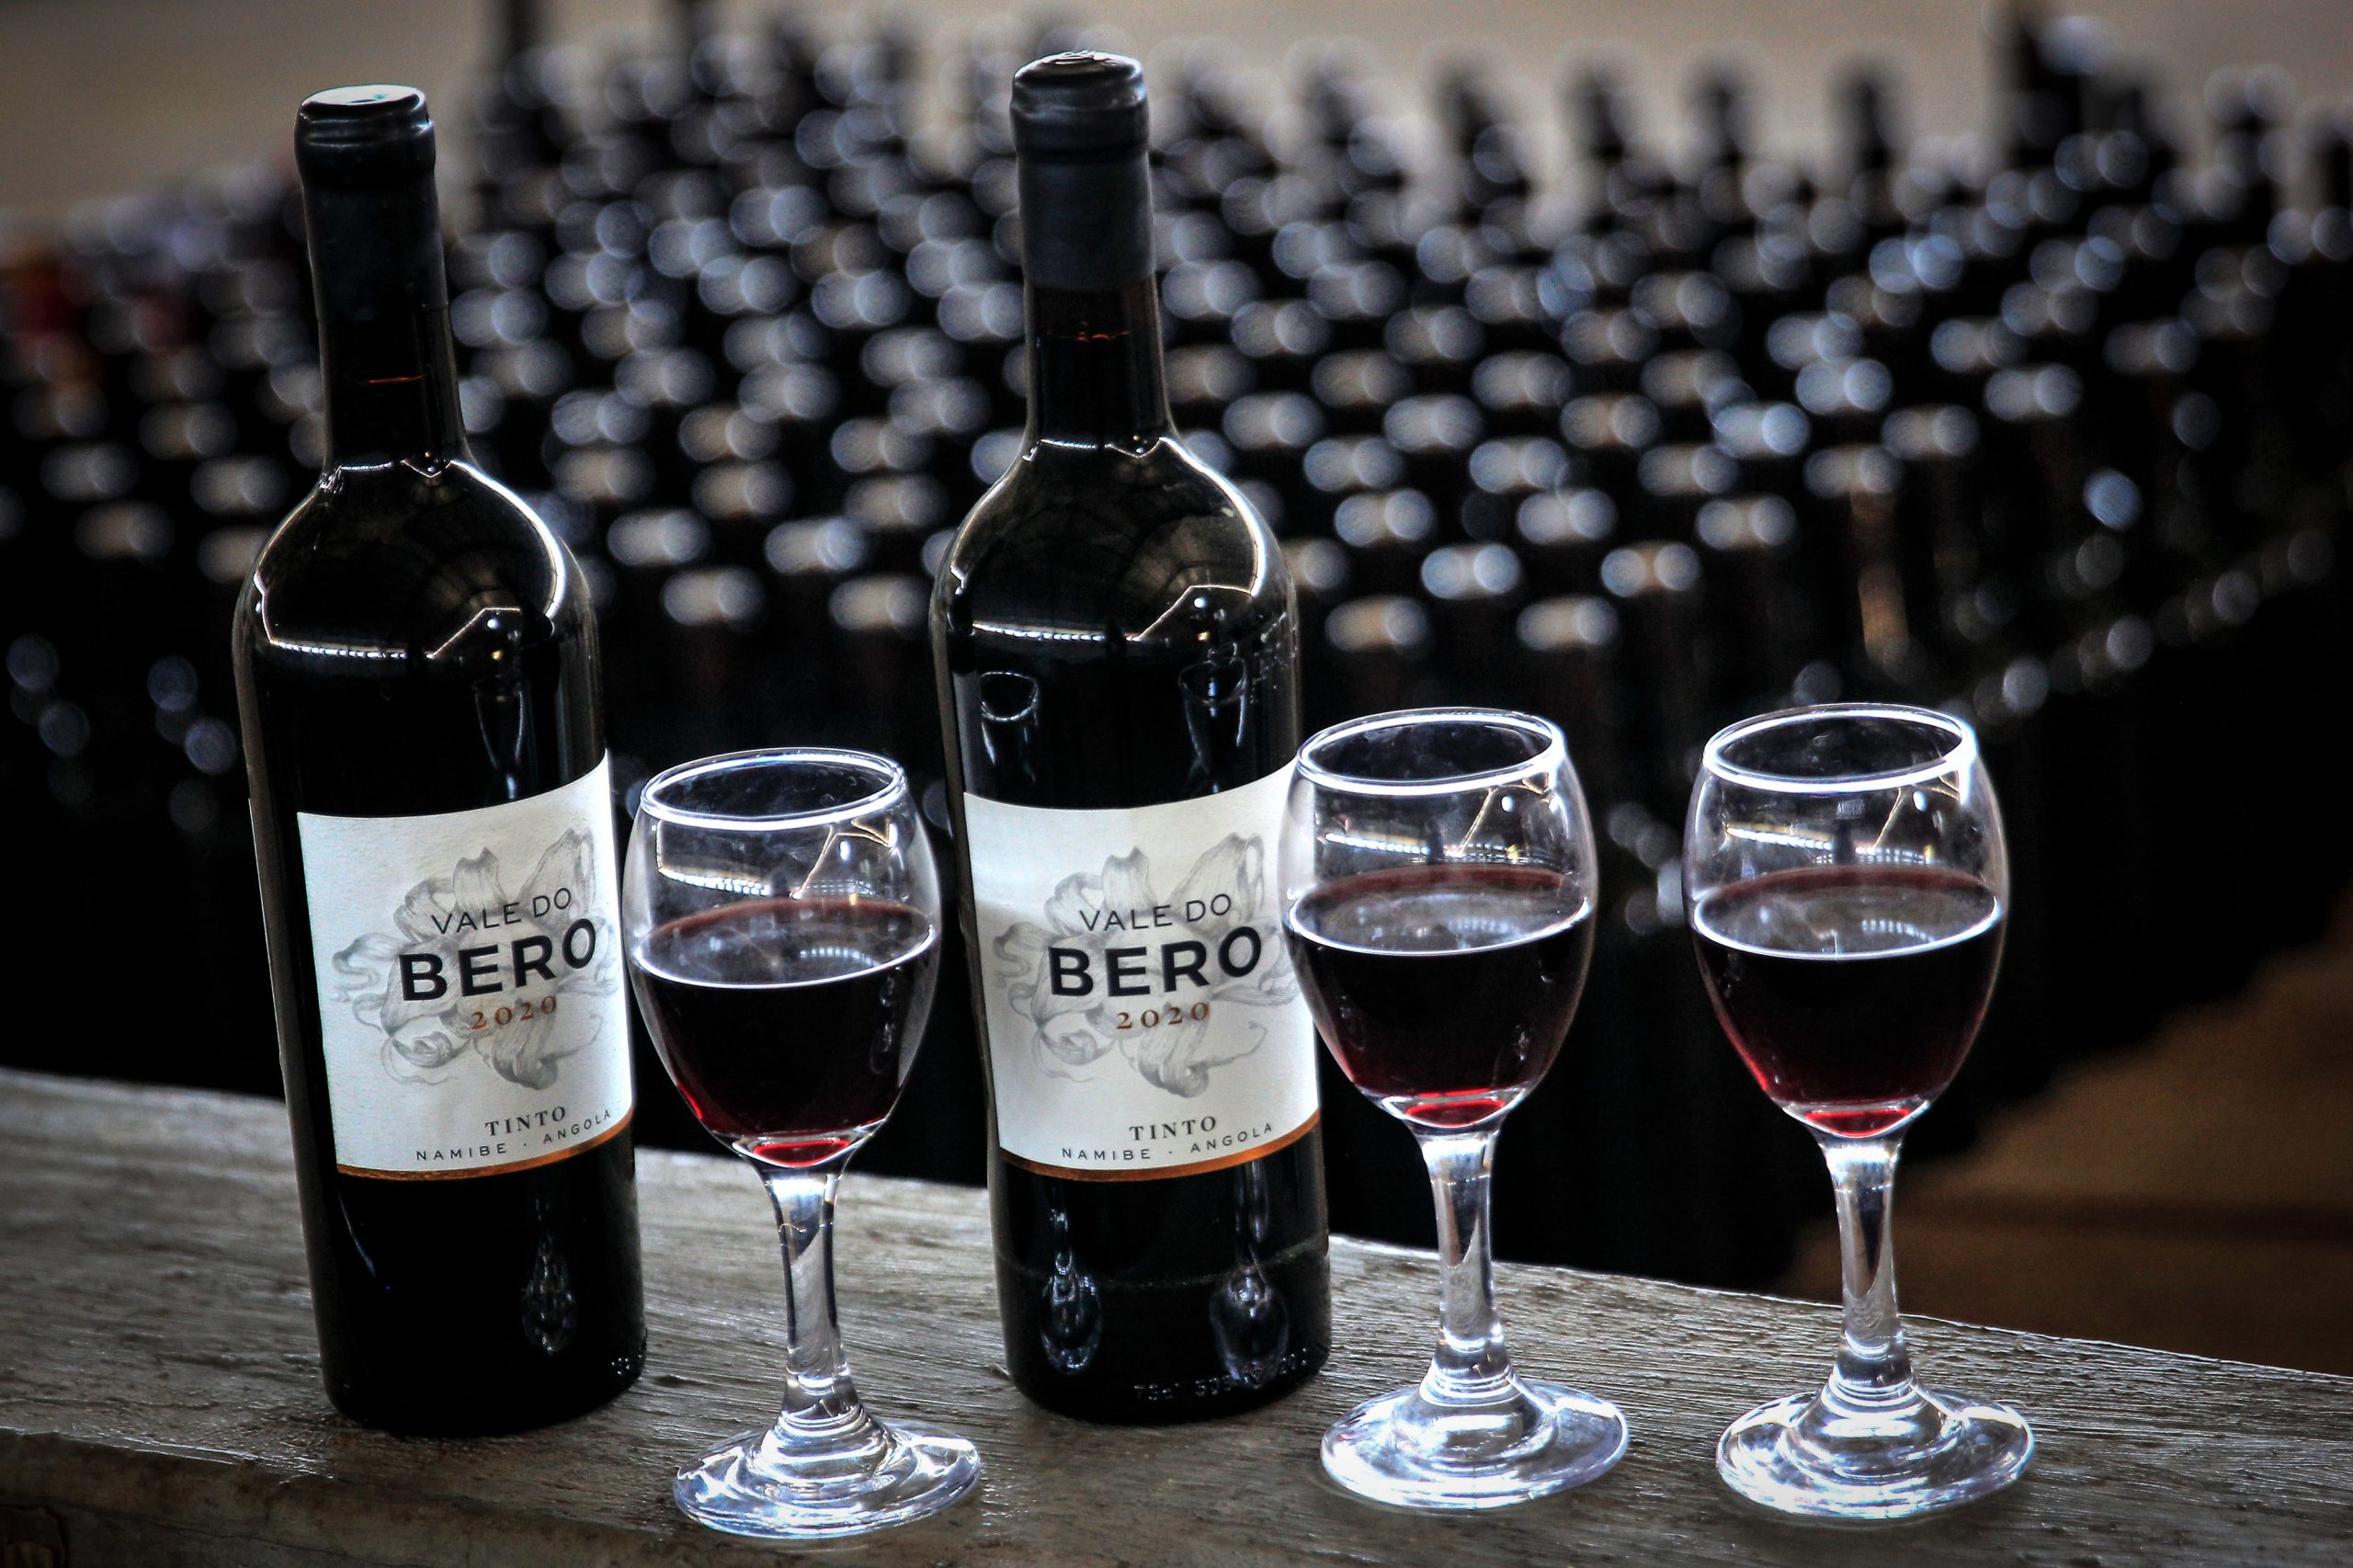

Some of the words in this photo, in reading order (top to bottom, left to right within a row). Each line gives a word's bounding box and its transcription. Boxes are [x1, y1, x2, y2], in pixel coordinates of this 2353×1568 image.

[431, 902, 521, 935] VALE
[532, 888, 572, 918] DO
[1079, 903, 1173, 932] VALE
[1185, 893, 1232, 923] DO
[399, 918, 597, 1001] BERO
[1049, 926, 1262, 997] BERO
[471, 995, 557, 1030] 2020
[1116, 1002, 1211, 1030] 2020
[416, 1142, 506, 1161] NAMIBE
[543, 1109, 610, 1143] ANGOLA
[485, 1106, 566, 1136] TINTO
[1130, 1116, 1216, 1141] TINTO
[1063, 1147, 1151, 1161] NAMIBE
[1190, 1122, 1272, 1153] ANGOLA
